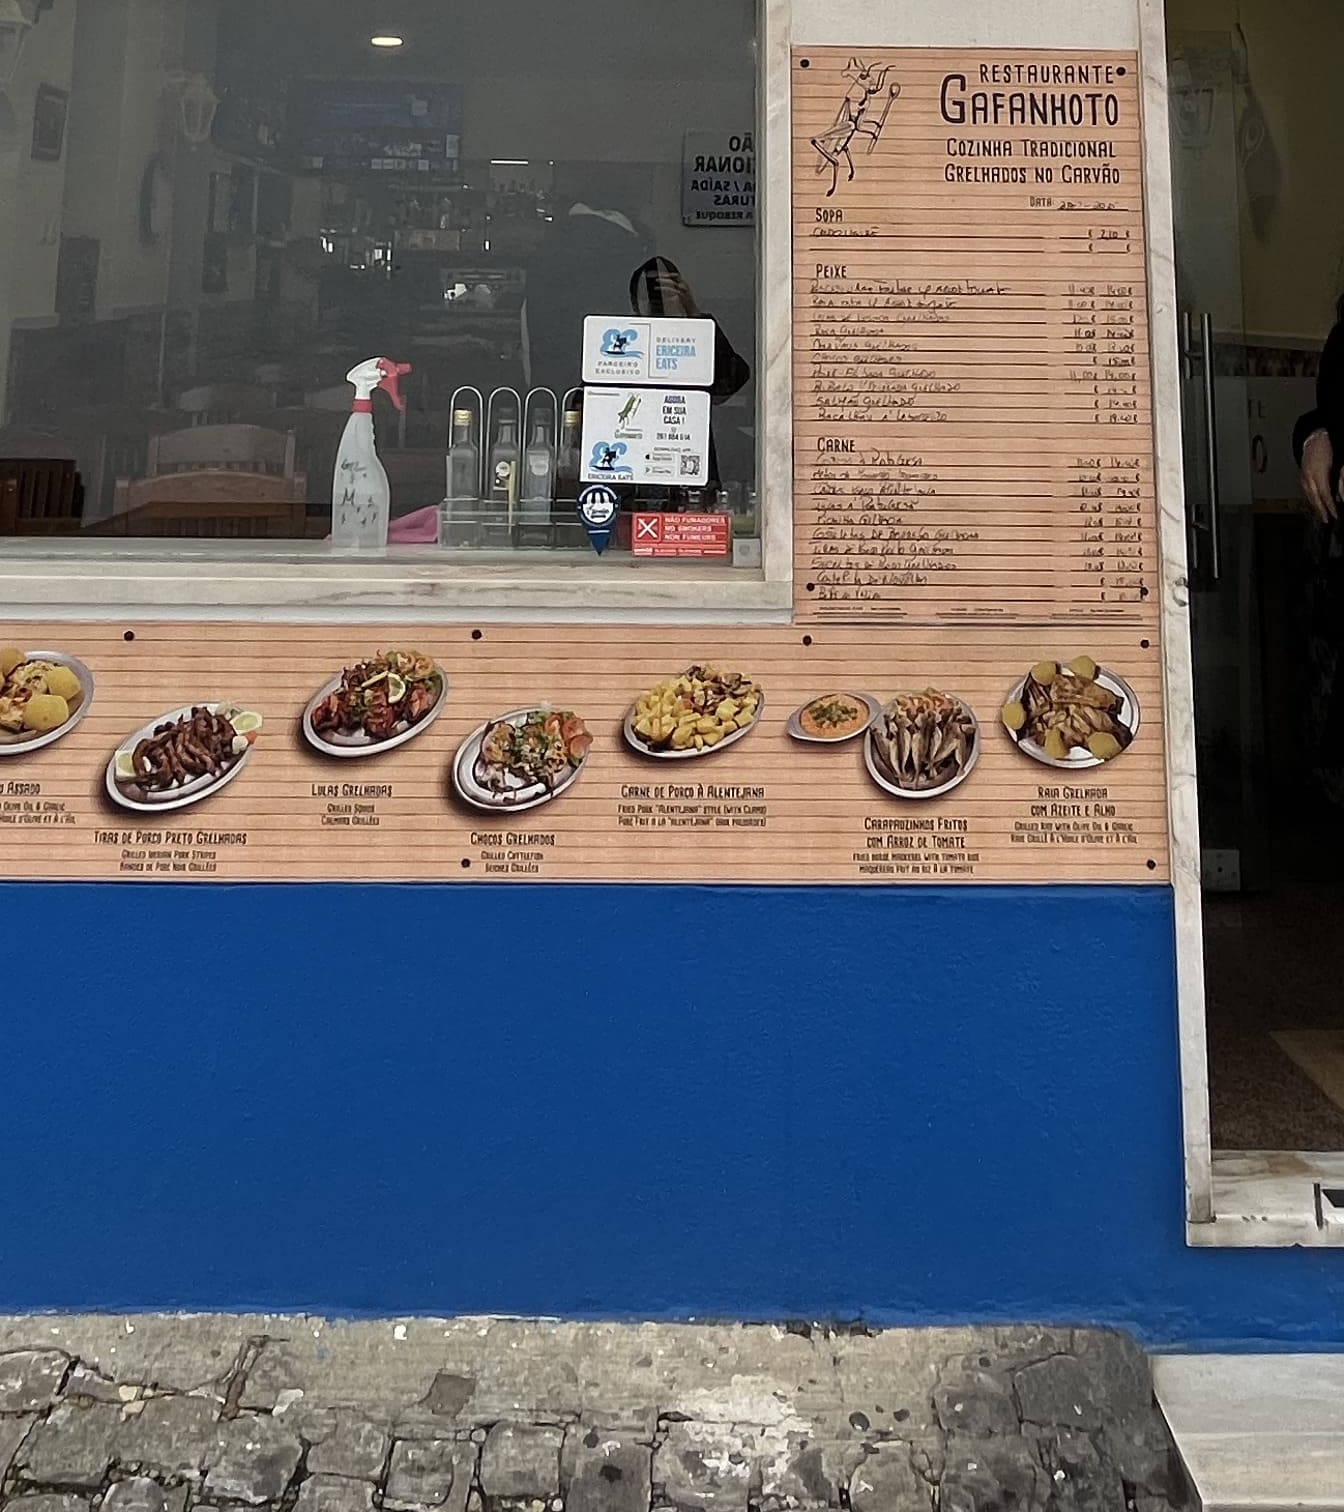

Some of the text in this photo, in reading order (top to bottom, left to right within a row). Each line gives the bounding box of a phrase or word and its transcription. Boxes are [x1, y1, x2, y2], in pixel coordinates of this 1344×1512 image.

[979, 64, 1114, 84] RESTAURANTE
[940, 74, 1119, 126] GAFANHOTO
[947, 138, 1117, 158] COZINHA TRADICIONAL
[945, 163, 1120, 184] GRELHADOS NO CARVÃO
[815, 208, 843, 222] SOPA
[816, 264, 847, 278] PEIXE
[656, 345, 696, 356] ERICEIRA
[656, 358, 678, 369] EATS
[664, 416, 680, 424] CASA
[817, 438, 856, 453] CARNE
[7, 781, 41, 795] ASSADO
[311, 784, 392, 798] LULAS GRELHADAS
[621, 783, 765, 799] CARNE DE PORCO À ALENTEJANA
[1062, 787, 1108, 800] GRELHADA
[1031, 804, 1116, 817] COM AZEITE E ALHO
[864, 817, 968, 831] CARAPAUZINHOS FRITOS
[94, 830, 247, 845] TIRAS DE PORCO PRETO GRELHADAS
[470, 832, 555, 846] CHOCOS GRELHADOS
[866, 836, 965, 848] COM ARROZ DE TOMATE
